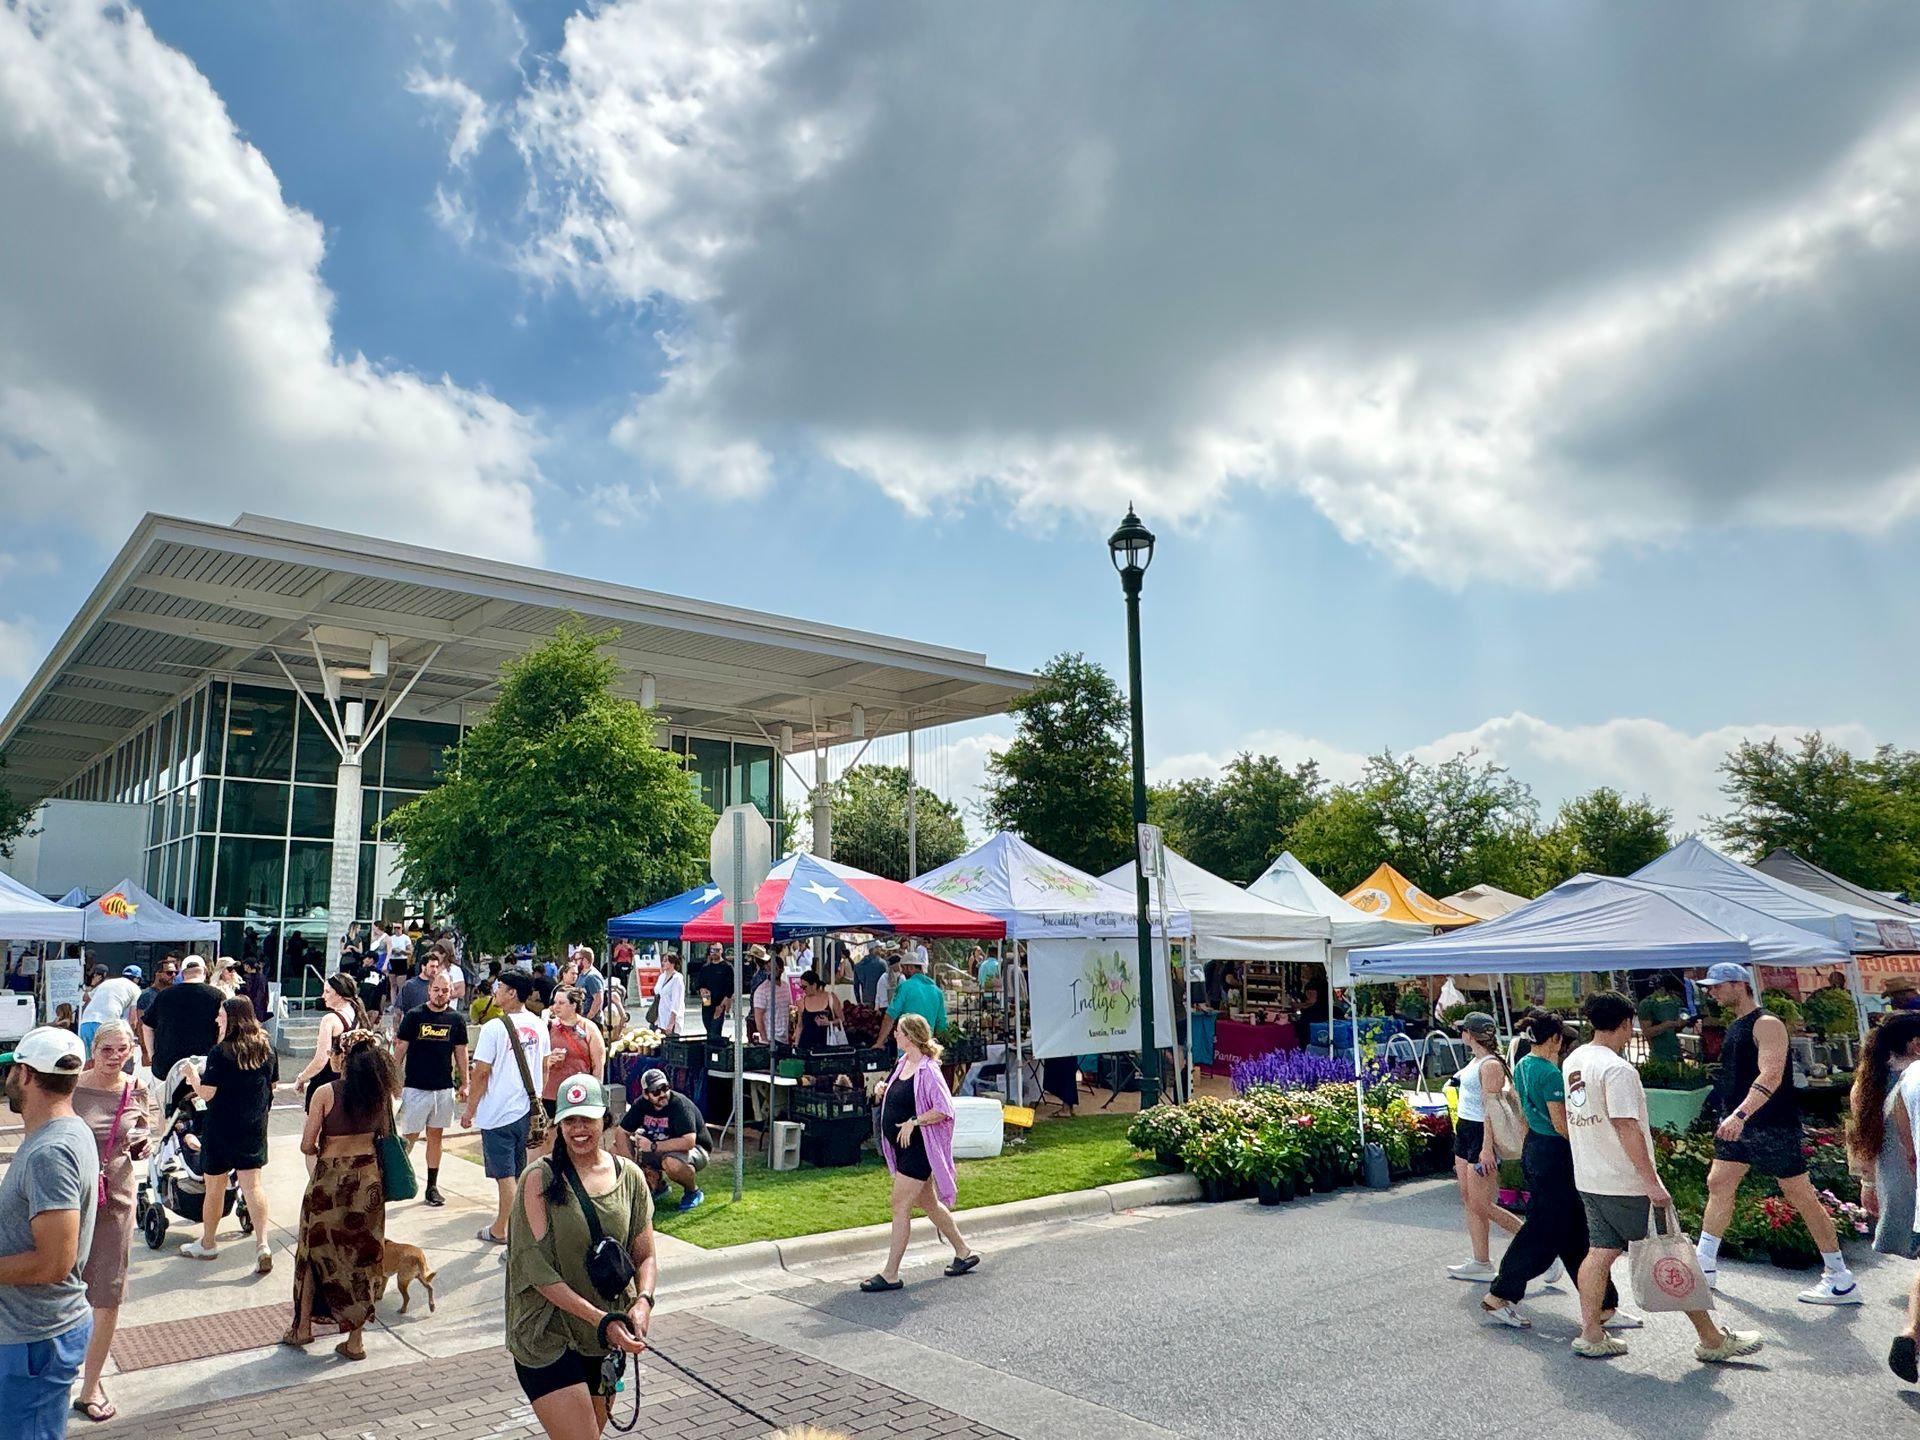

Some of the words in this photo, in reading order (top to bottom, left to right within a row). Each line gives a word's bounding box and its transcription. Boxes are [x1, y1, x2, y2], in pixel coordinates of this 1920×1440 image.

[1042, 912, 1079, 928] Succulents
[1068, 978, 1117, 1024] Indigo
[1119, 979, 1142, 1015] Soi
[1088, 1028, 1109, 1038] Austin,
[1110, 1027, 1127, 1036] Texas
[1214, 1050, 1242, 1064] Pantry
